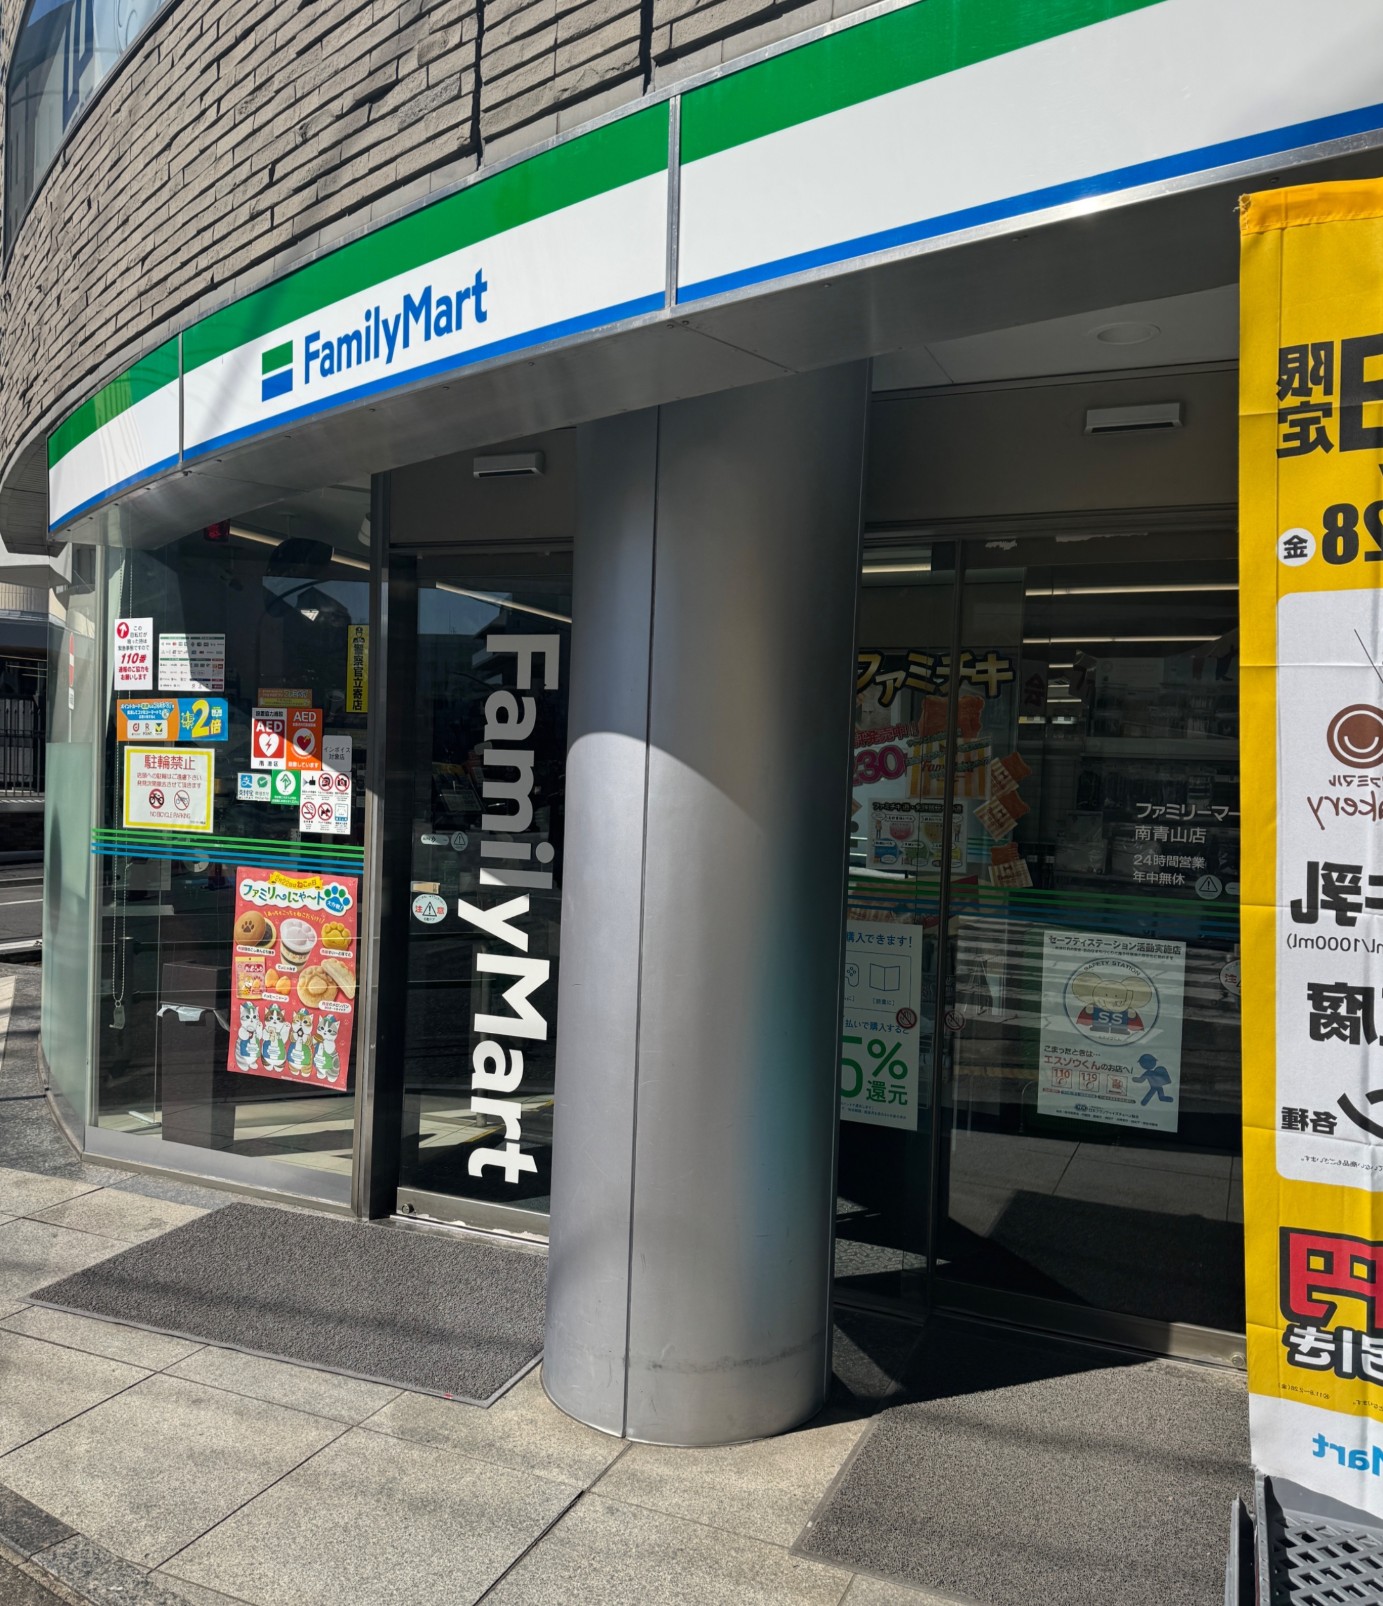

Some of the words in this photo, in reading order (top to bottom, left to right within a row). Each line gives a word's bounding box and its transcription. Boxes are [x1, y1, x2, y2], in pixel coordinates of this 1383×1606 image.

[304, 267, 488, 385] FamilyMart
[121, 653, 146, 664] 110番
[352, 644, 364, 711] 警察官立寄店
[857, 651, 1015, 707] ファミチキ
[293, 711, 317, 722] AED
[256, 721, 283, 733] AED
[324, 746, 351, 754] インボイス
[328, 753, 345, 761] 対象店
[144, 755, 195, 771] 駐輪禁止
[1135, 825, 1206, 844] 南青山店
[1133, 854, 1206, 869] 24時間営業
[1132, 871, 1185, 885] 年中無休
[458, 634, 560, 1183] FamilyMart
[846, 931, 913, 948] 購入できます!
[1048, 936, 1182, 956] セーフティステーション活動実施店
[1111, 960, 1141, 976] STATION
[1098, 1011, 1124, 1025] SS
[1054, 1068, 1071, 1080] 110
[1081, 1072, 1098, 1082] 119
[866, 1079, 908, 1106] 還元
